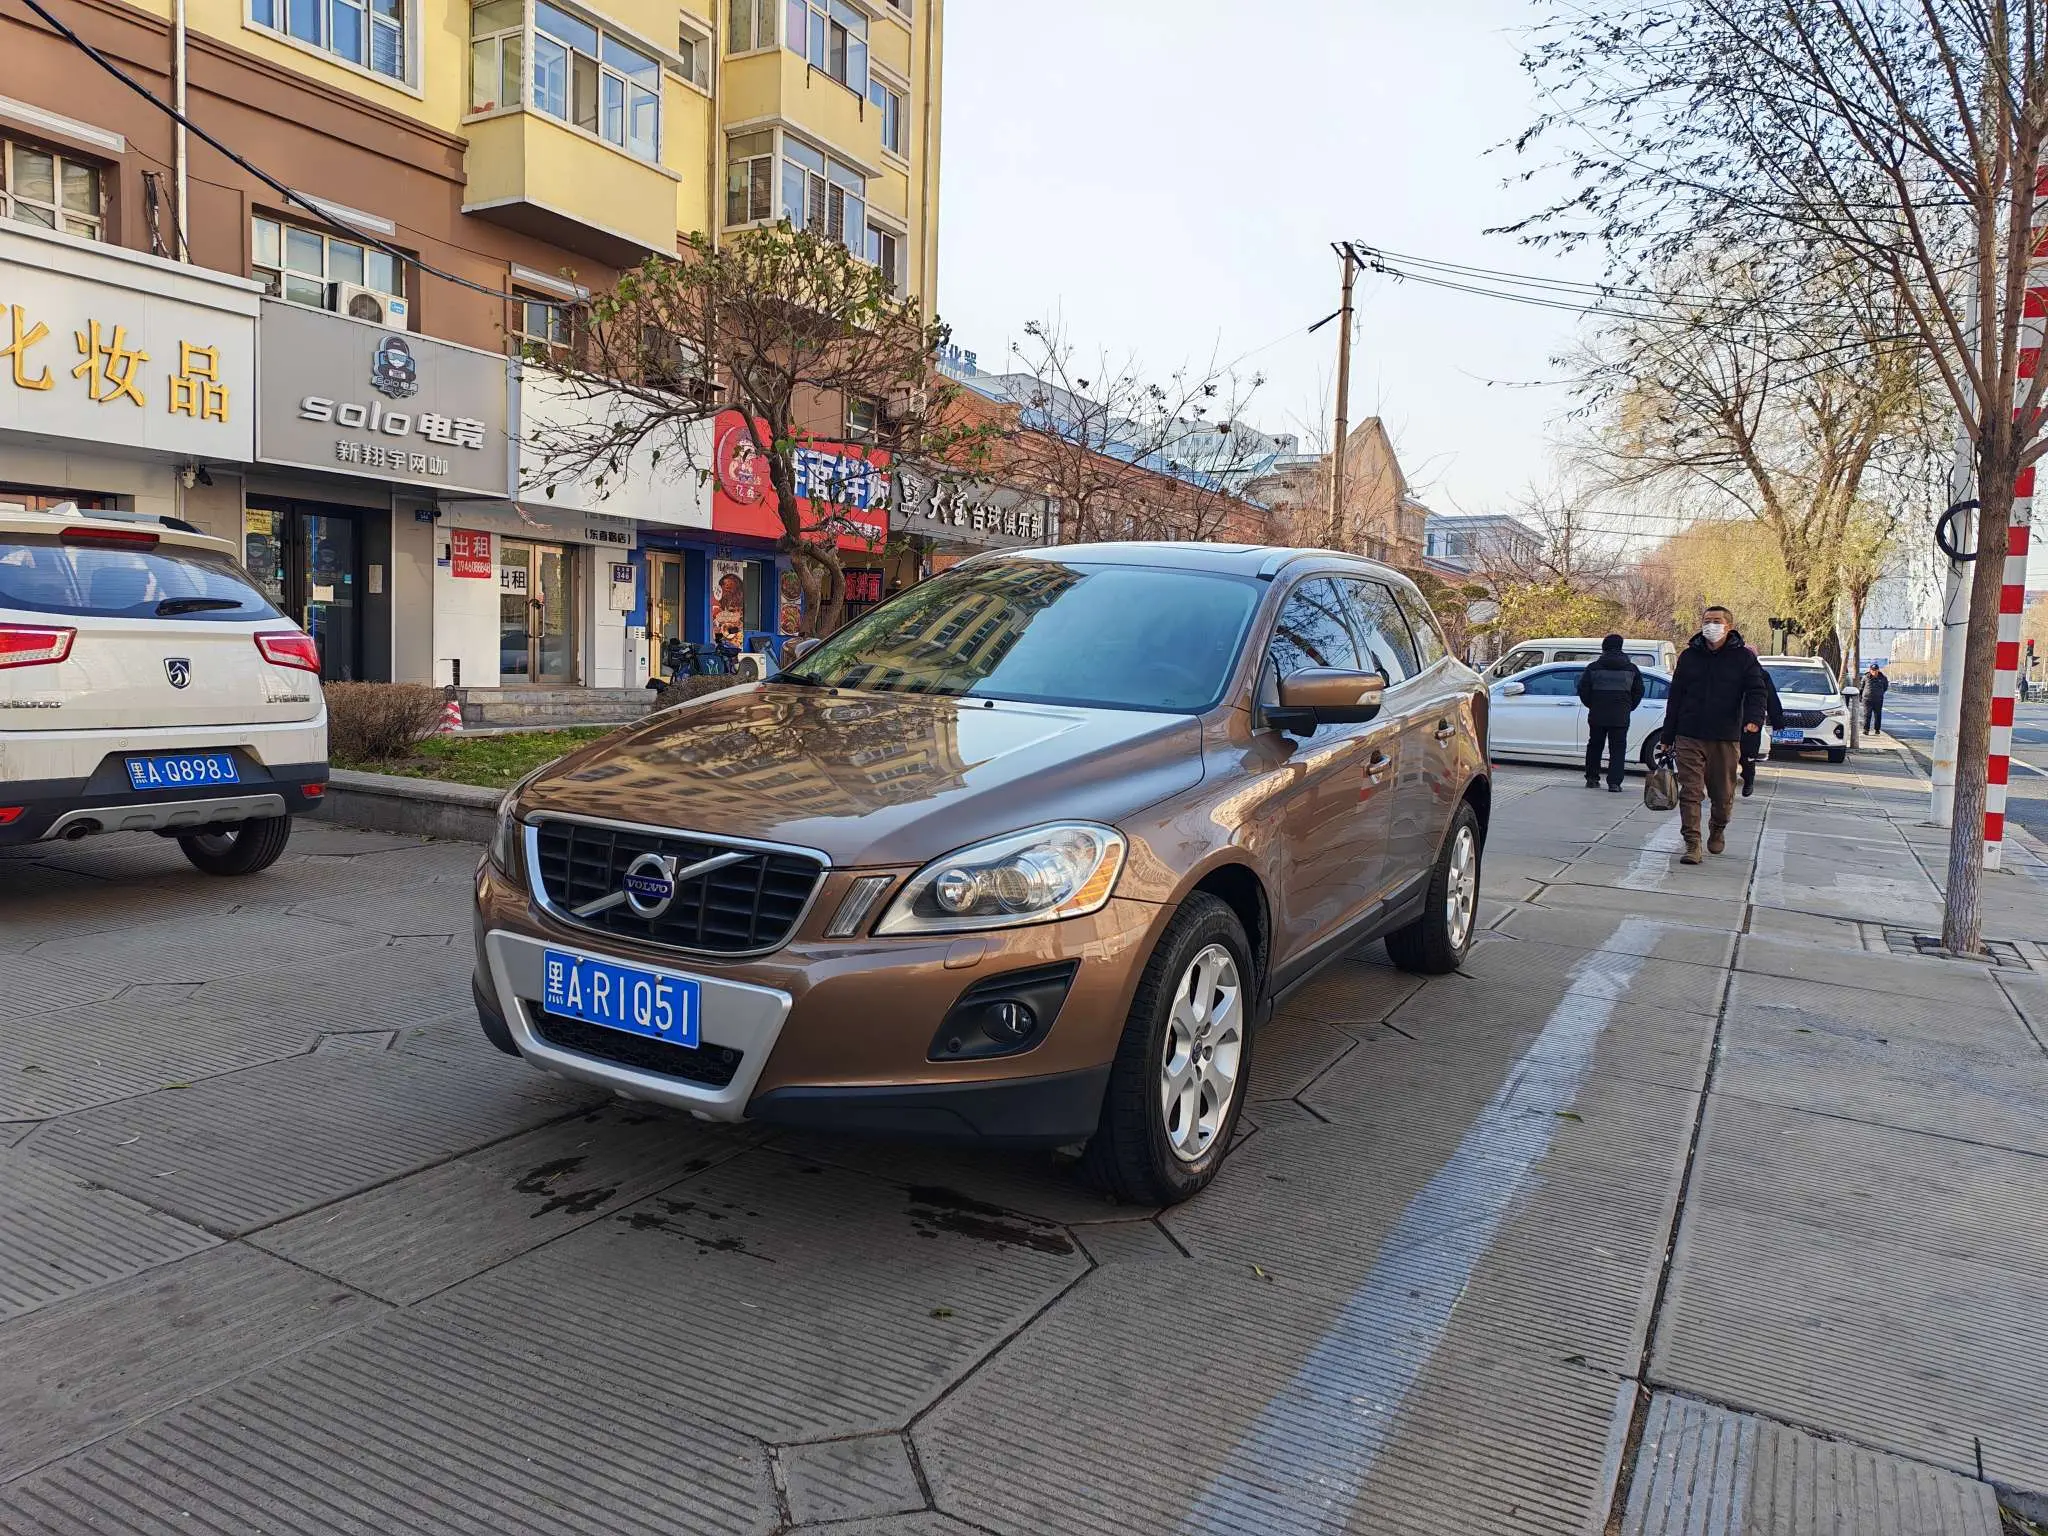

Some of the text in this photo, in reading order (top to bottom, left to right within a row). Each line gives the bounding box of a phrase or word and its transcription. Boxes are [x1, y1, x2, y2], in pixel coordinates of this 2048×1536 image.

[0, 303, 230, 423] 化妆品
[416, 412, 487, 450] 电竞
[336, 440, 449, 475] 新翔宇网咖
[453, 534, 490, 558] 出租
[500, 568, 526, 589] 出租
[627, 879, 668, 894] VOLVO
